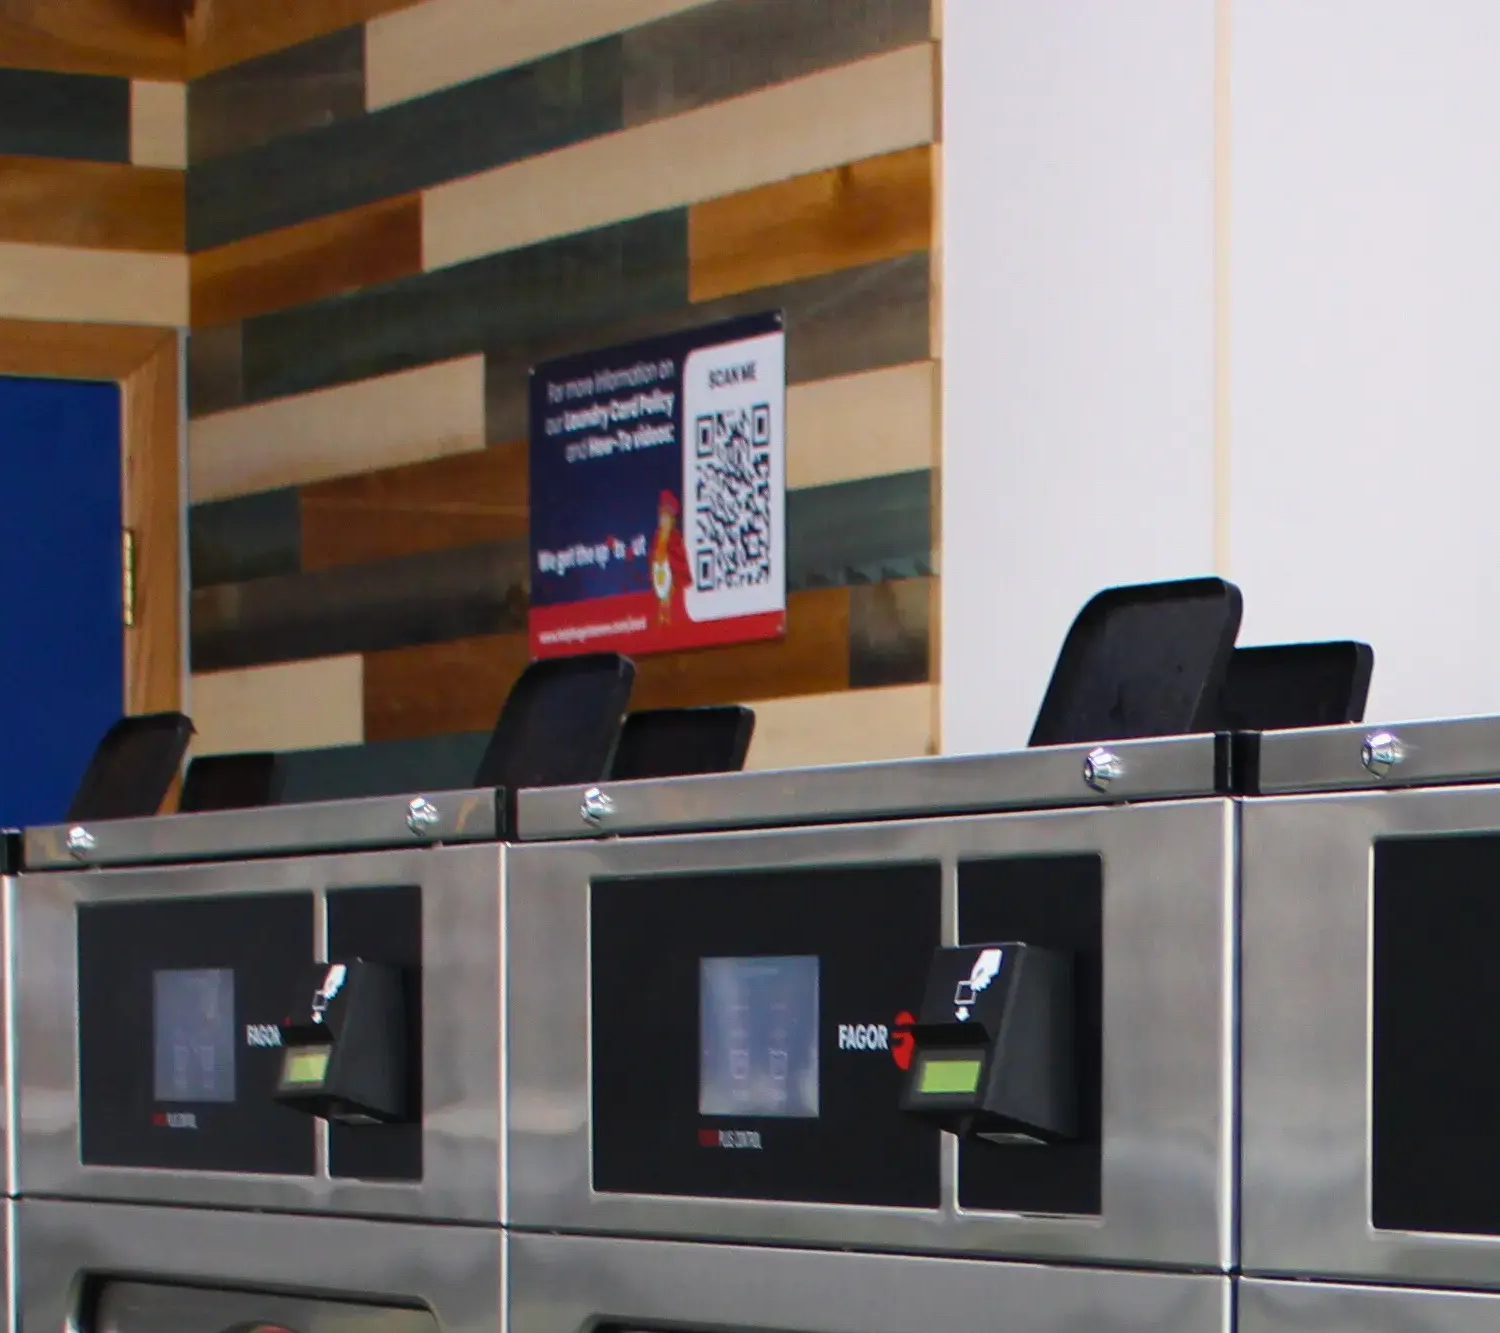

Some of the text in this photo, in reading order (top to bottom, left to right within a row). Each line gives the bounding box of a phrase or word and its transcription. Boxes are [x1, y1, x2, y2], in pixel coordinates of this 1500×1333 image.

[566, 377, 593, 400] more
[594, 361, 658, 393] information
[708, 360, 758, 391] SCAN ME
[563, 401, 609, 432] Laundry
[837, 1023, 890, 1051] FAGOR
